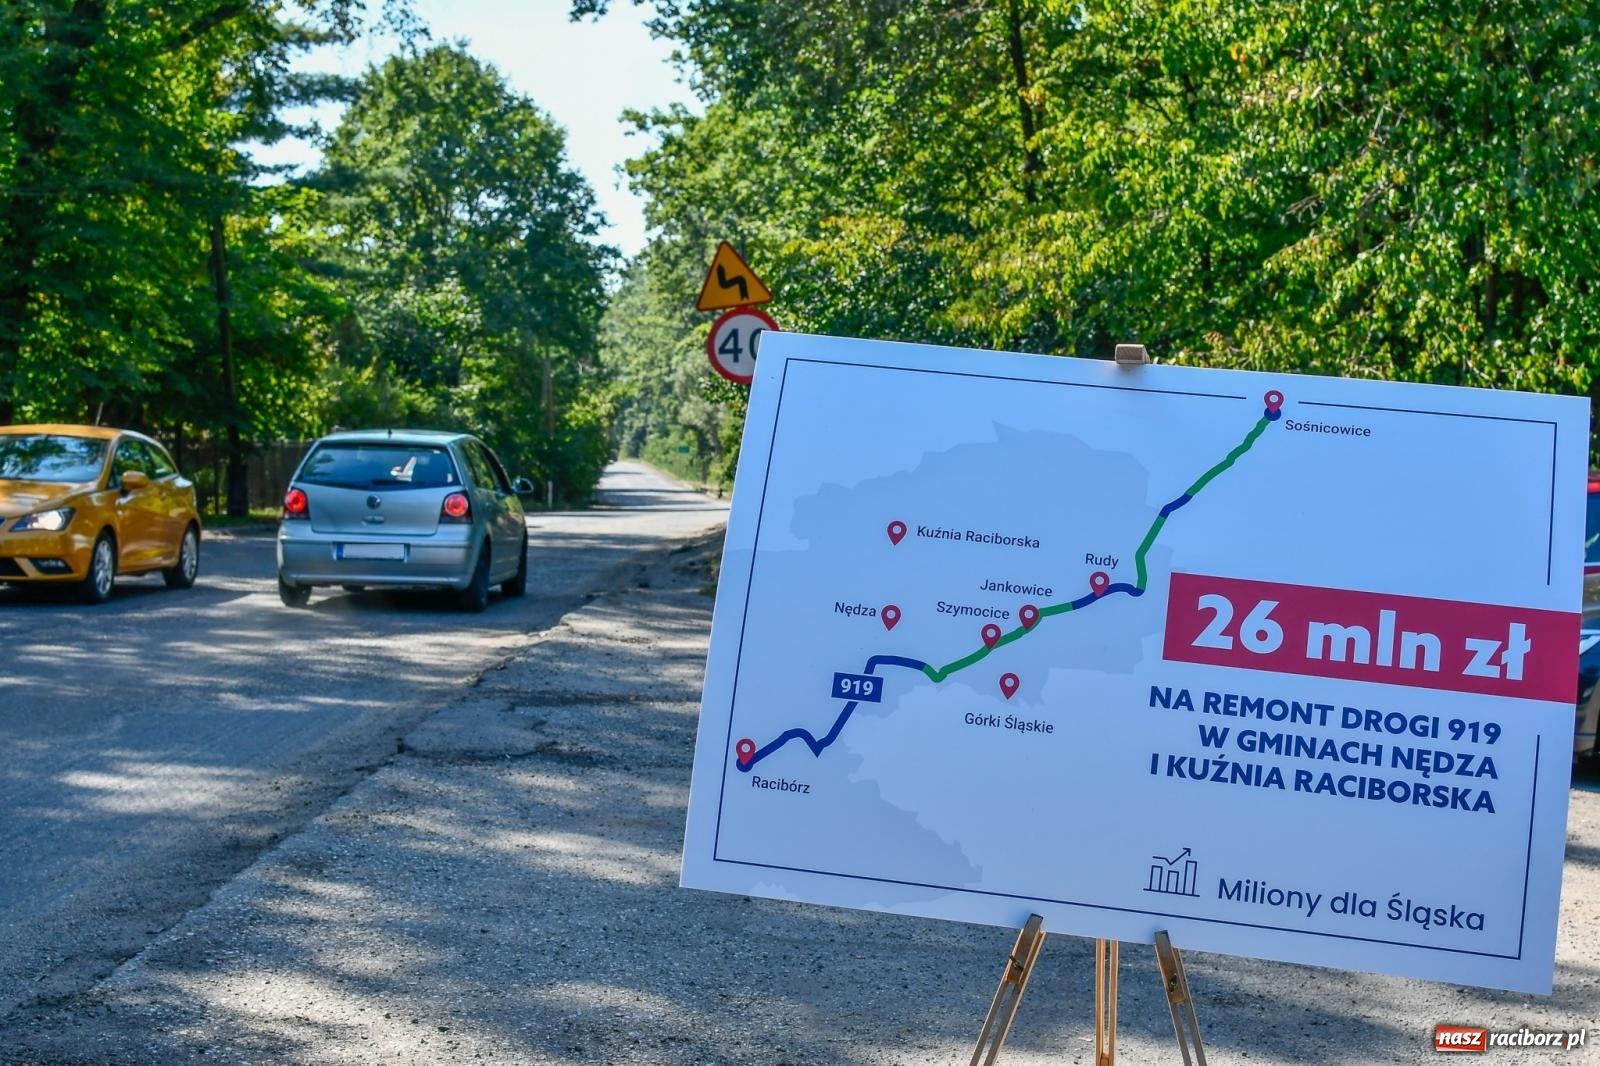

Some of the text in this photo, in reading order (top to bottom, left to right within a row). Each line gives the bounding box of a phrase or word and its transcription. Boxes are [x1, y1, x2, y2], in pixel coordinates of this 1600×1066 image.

[1286, 420, 1370, 436] Sośnicowice
[917, 526, 1039, 548] Kuźnia Raciborska
[1086, 553, 1119, 569] Rudy
[980, 580, 1052, 596] Jankowice
[835, 602, 876, 617] Nędza
[937, 601, 1009, 619] Szymocice
[1192, 594, 1531, 680] 26 mln zł
[840, 679, 874, 696] 919
[965, 713, 1053, 733] Górki Śląskie
[1150, 686, 1501, 744] NA REMONT DROGI 919
[1199, 725, 1498, 779] W GMINACH NĘDZA
[752, 776, 810, 793] Racibórz
[1151, 753, 1495, 813] I KUŹNIA RACIBORSKA
[1218, 879, 1484, 930] Miliony dla Śląska
